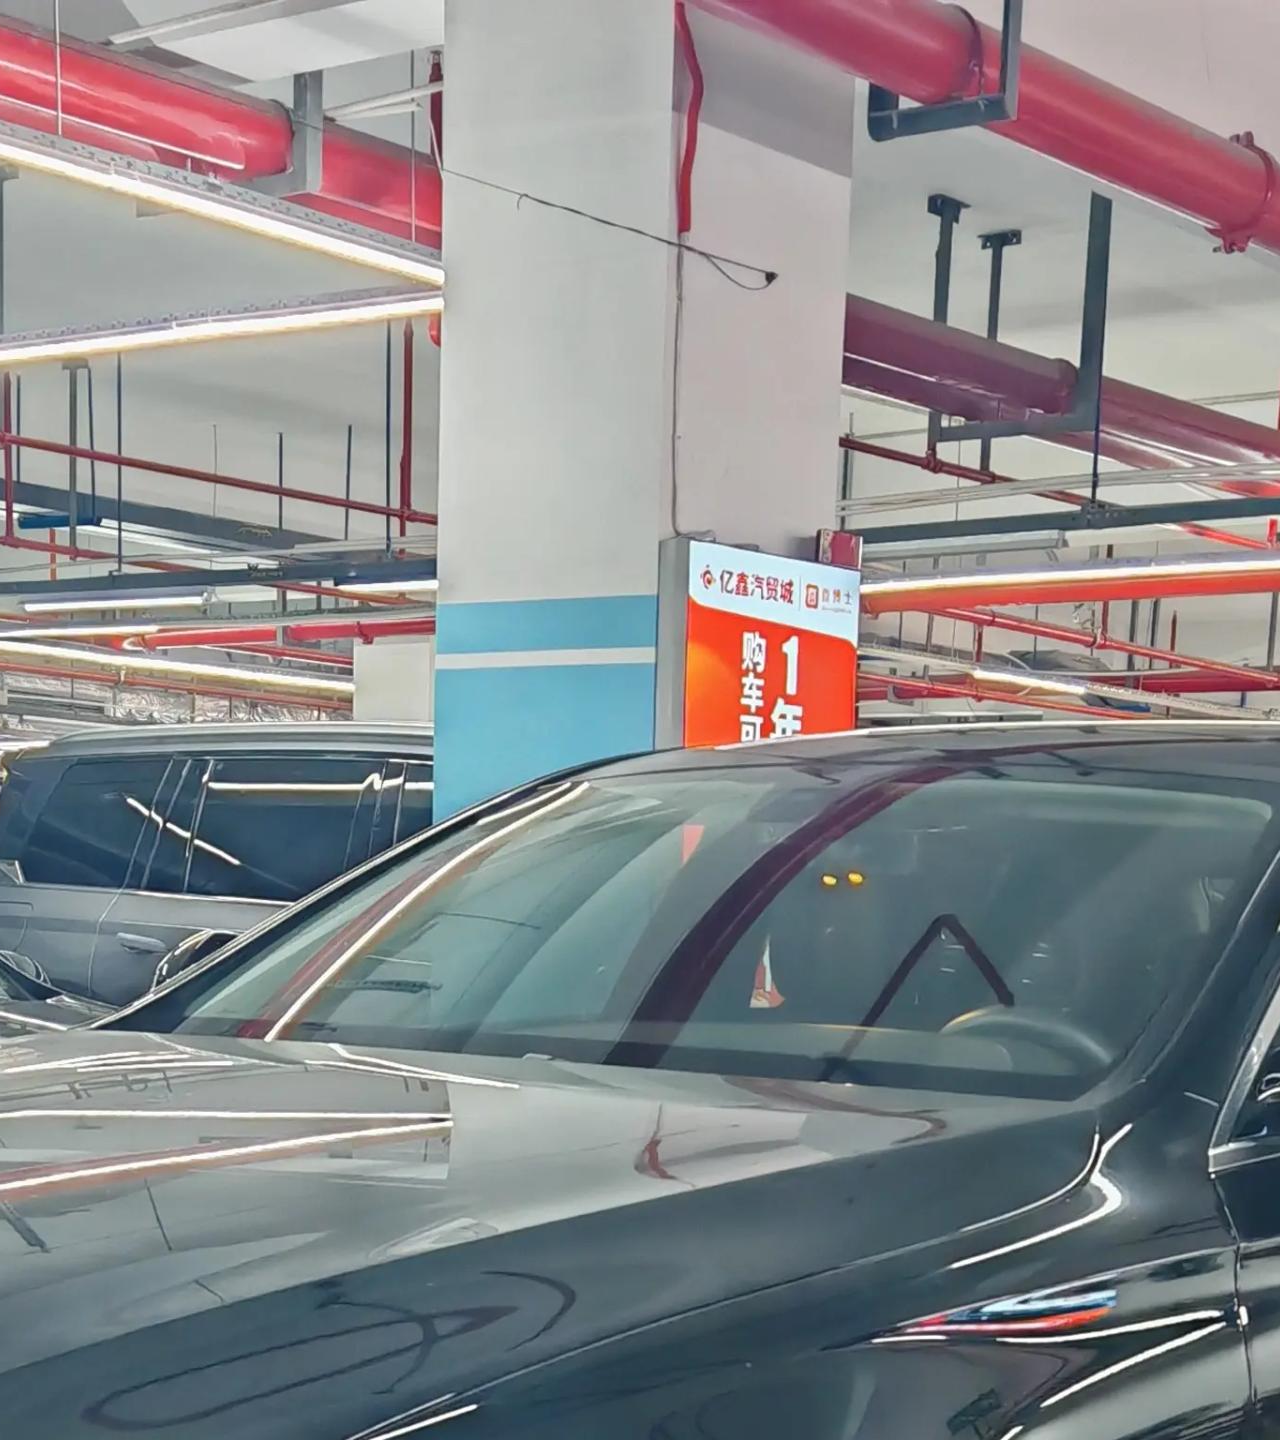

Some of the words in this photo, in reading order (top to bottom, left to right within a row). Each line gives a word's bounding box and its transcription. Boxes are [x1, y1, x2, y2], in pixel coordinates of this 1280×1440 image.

[720, 569, 794, 605] 亿鑫汽贸城
